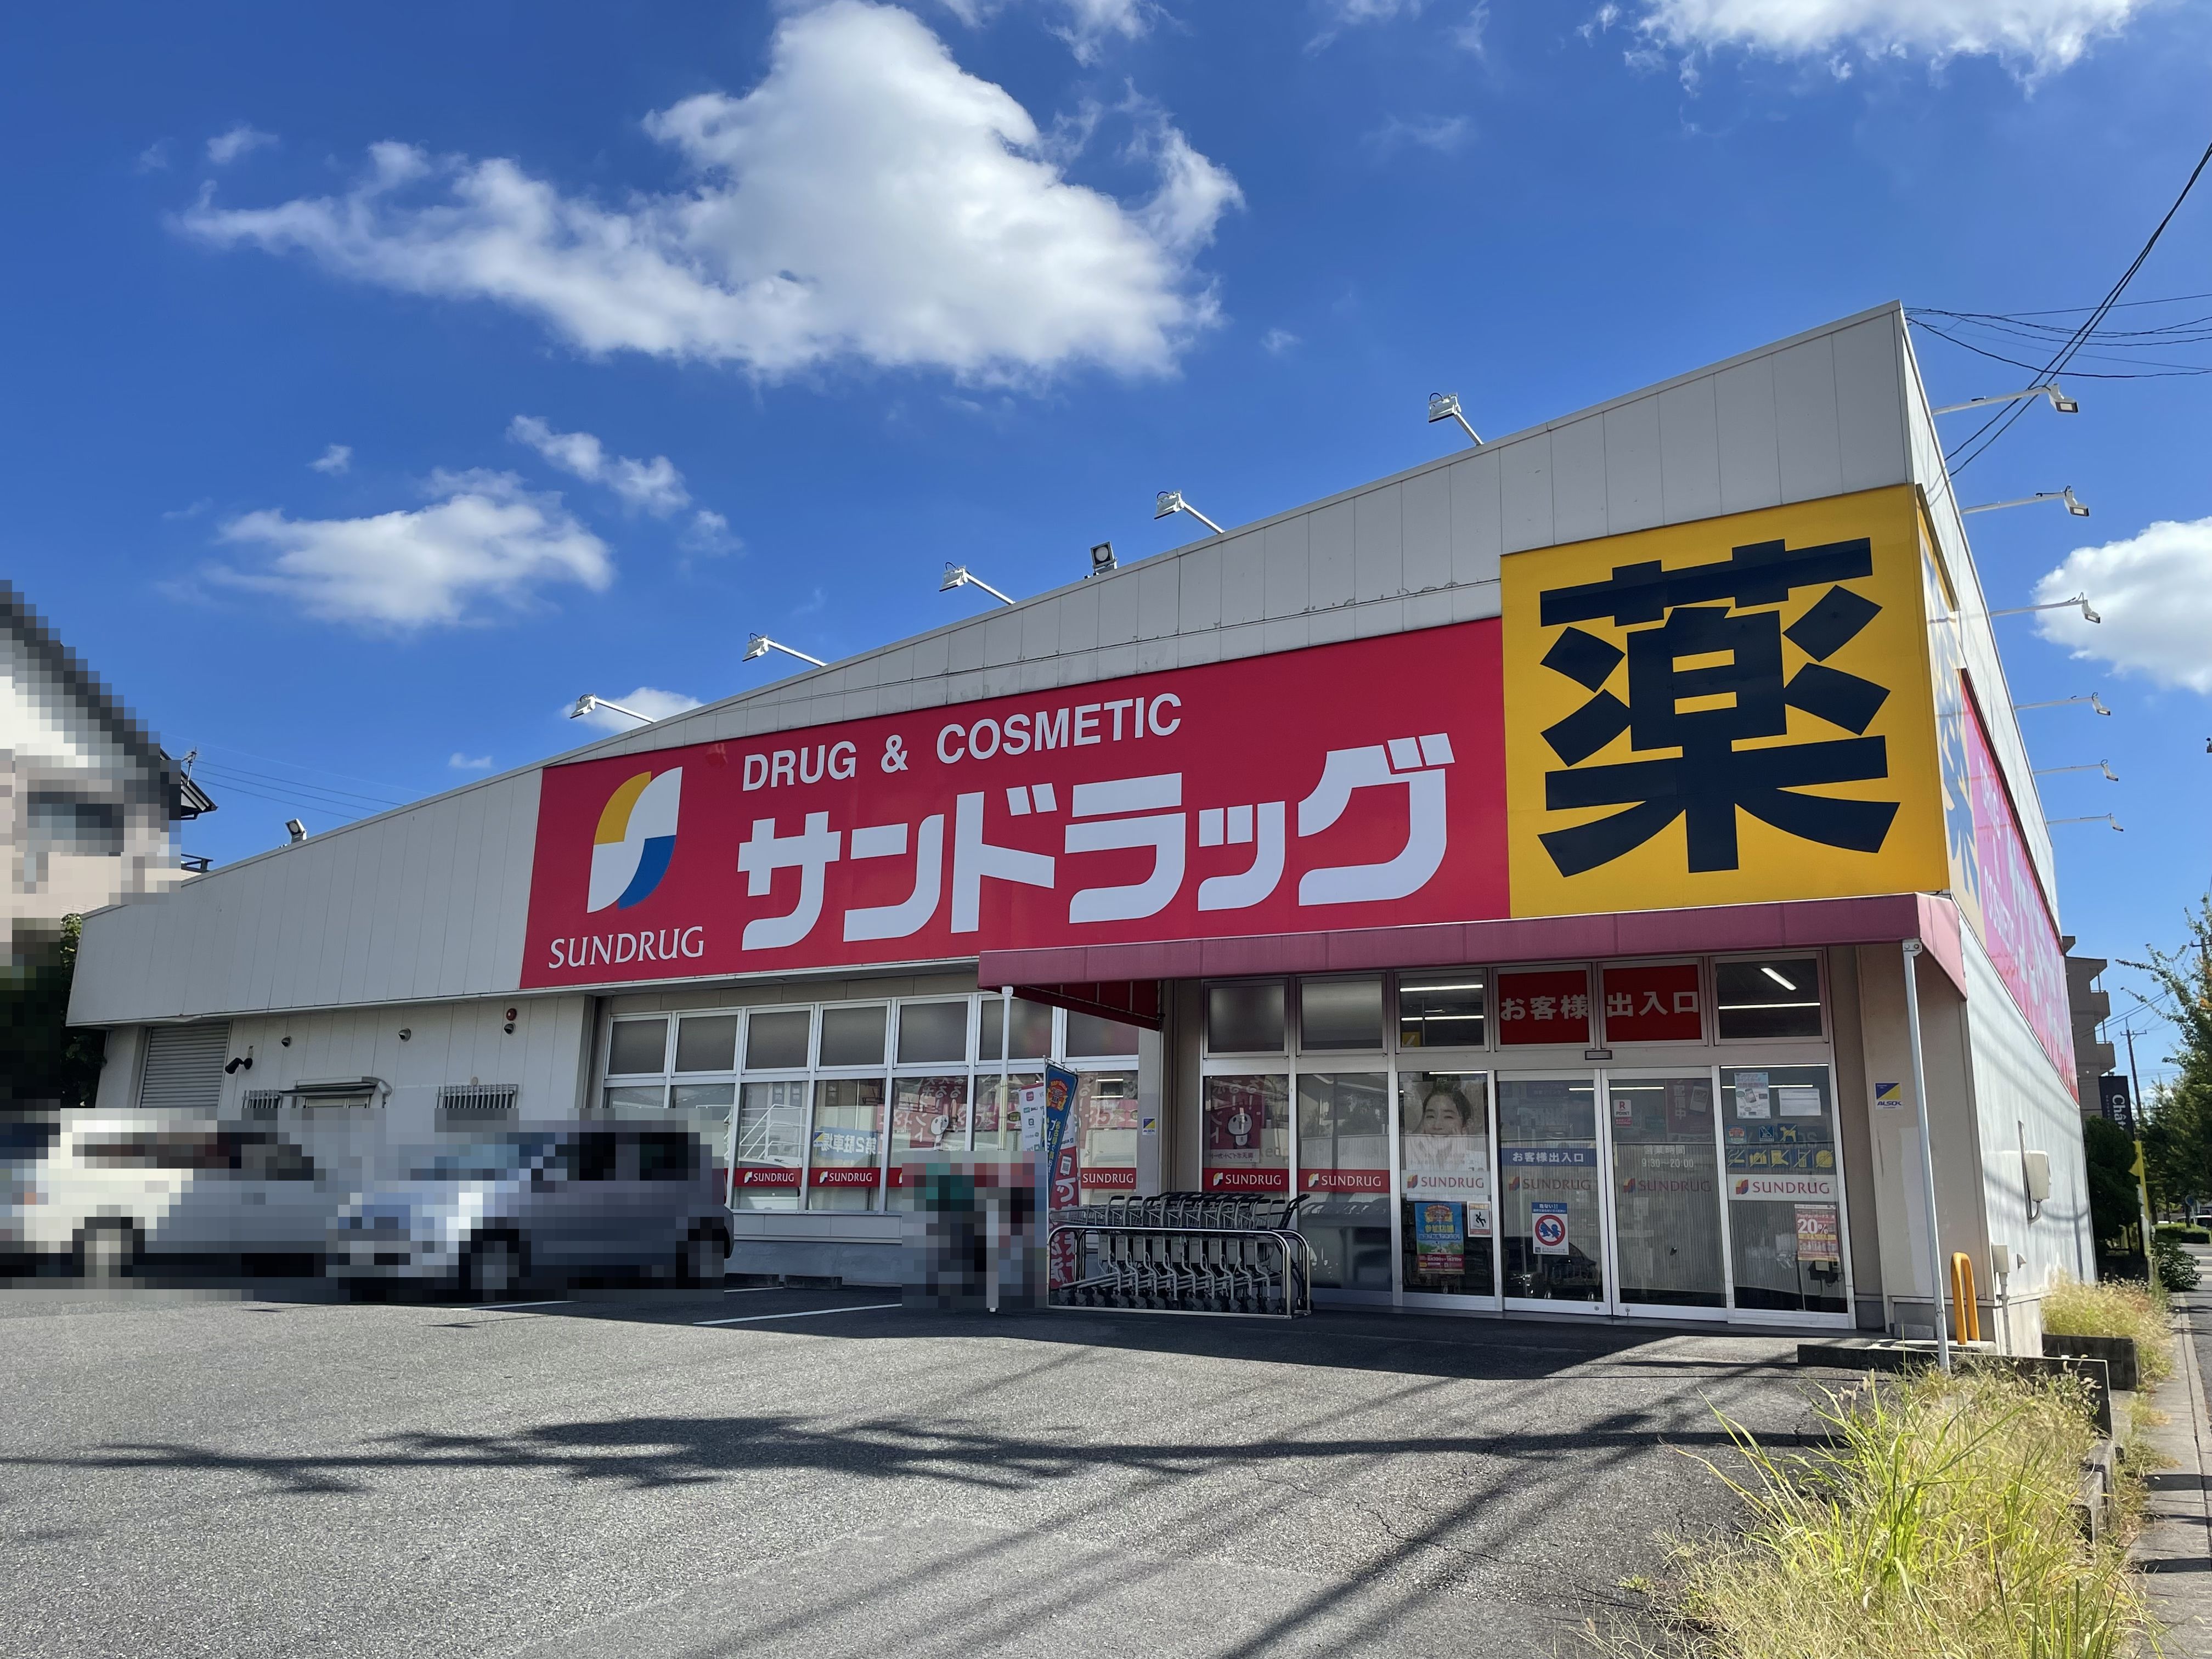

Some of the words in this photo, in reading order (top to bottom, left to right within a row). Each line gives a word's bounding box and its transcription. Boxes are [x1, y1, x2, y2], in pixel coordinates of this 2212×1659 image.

[1537, 537, 1900, 878] 薬
[742, 740, 856, 791] DRUG
[880, 735, 909, 774] &
[936, 692, 1182, 764] COSMETIC
[737, 732, 1455, 951] サンドラッグ
[549, 926, 704, 969] SUNDRUG
[1500, 994, 1590, 1021] お客様
[1607, 990, 1699, 1017] 出入口
[1513, 1152, 1584, 1163] お客様出入口
[753, 1172, 794, 1182] SUNDRUG
[828, 1171, 873, 1183] SUNDRUG
[1083, 1173, 1133, 1183] SUNDRUG
[1225, 1174, 1282, 1185] SUNDRUG
[1321, 1175, 1381, 1188] SUNDRUG
[1421, 1177, 1485, 1188] SUNDRUG
[1523, 1178, 1591, 1190] SUNDRUG
[1639, 1180, 1712, 1192] SUNDRUG
[1752, 1182, 1830, 1194] SUNDRUG
